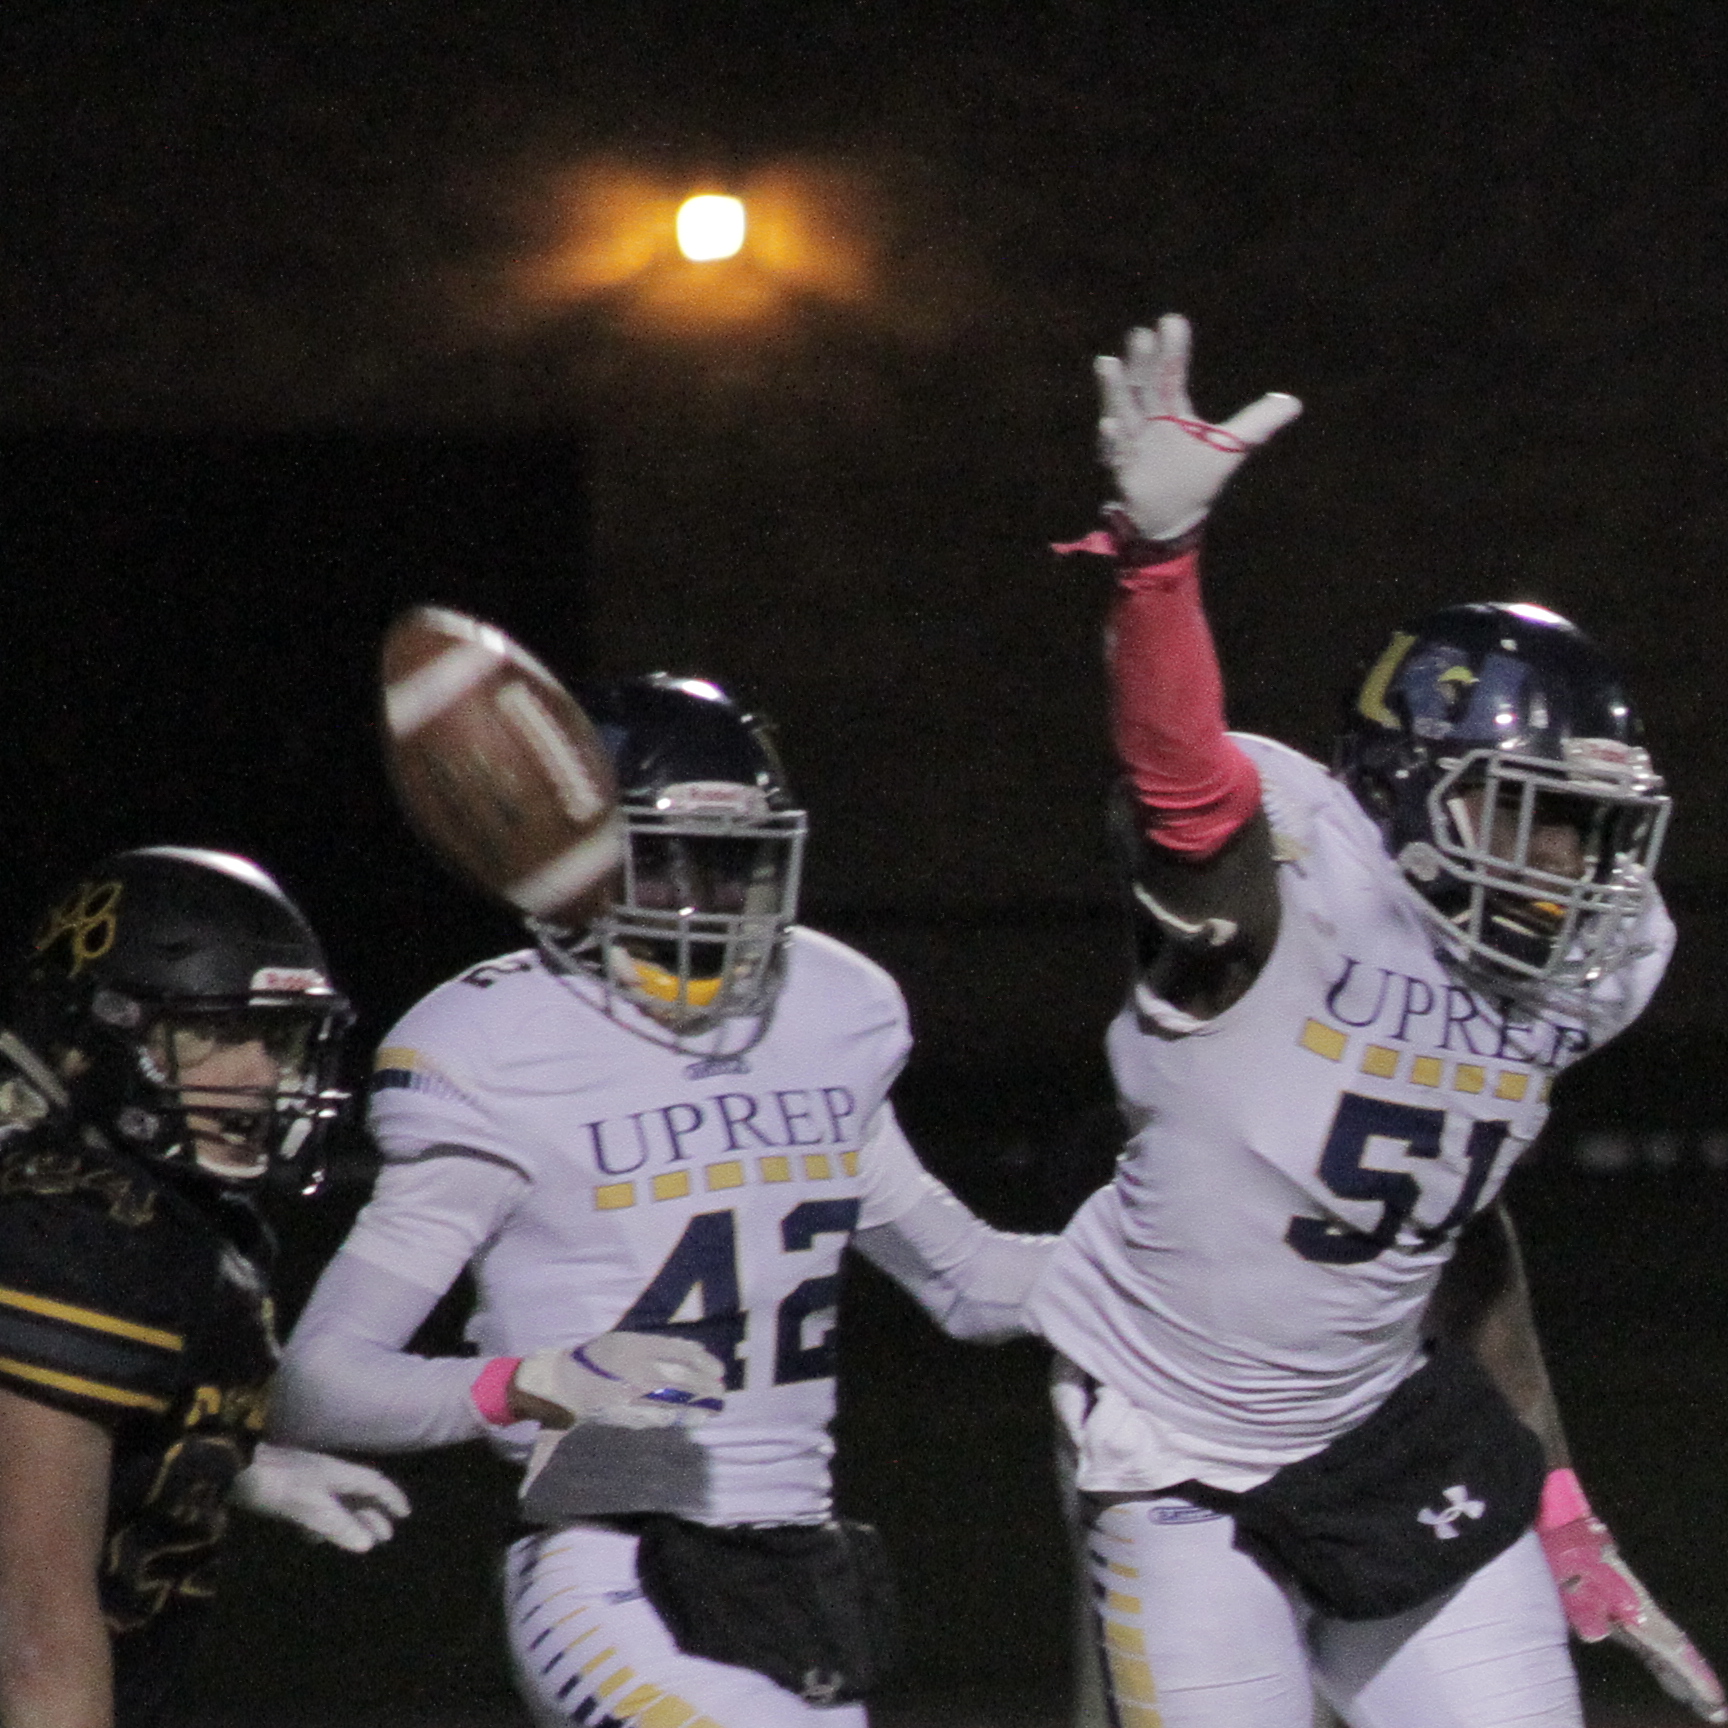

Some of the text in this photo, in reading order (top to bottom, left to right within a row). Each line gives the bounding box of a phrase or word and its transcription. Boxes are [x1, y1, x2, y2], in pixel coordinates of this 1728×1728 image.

[1326, 955, 1591, 1067] UPREP
[582, 1086, 855, 1176] UPREP
[1285, 1090, 1512, 1264] 51
[610, 1196, 862, 1391] 42
